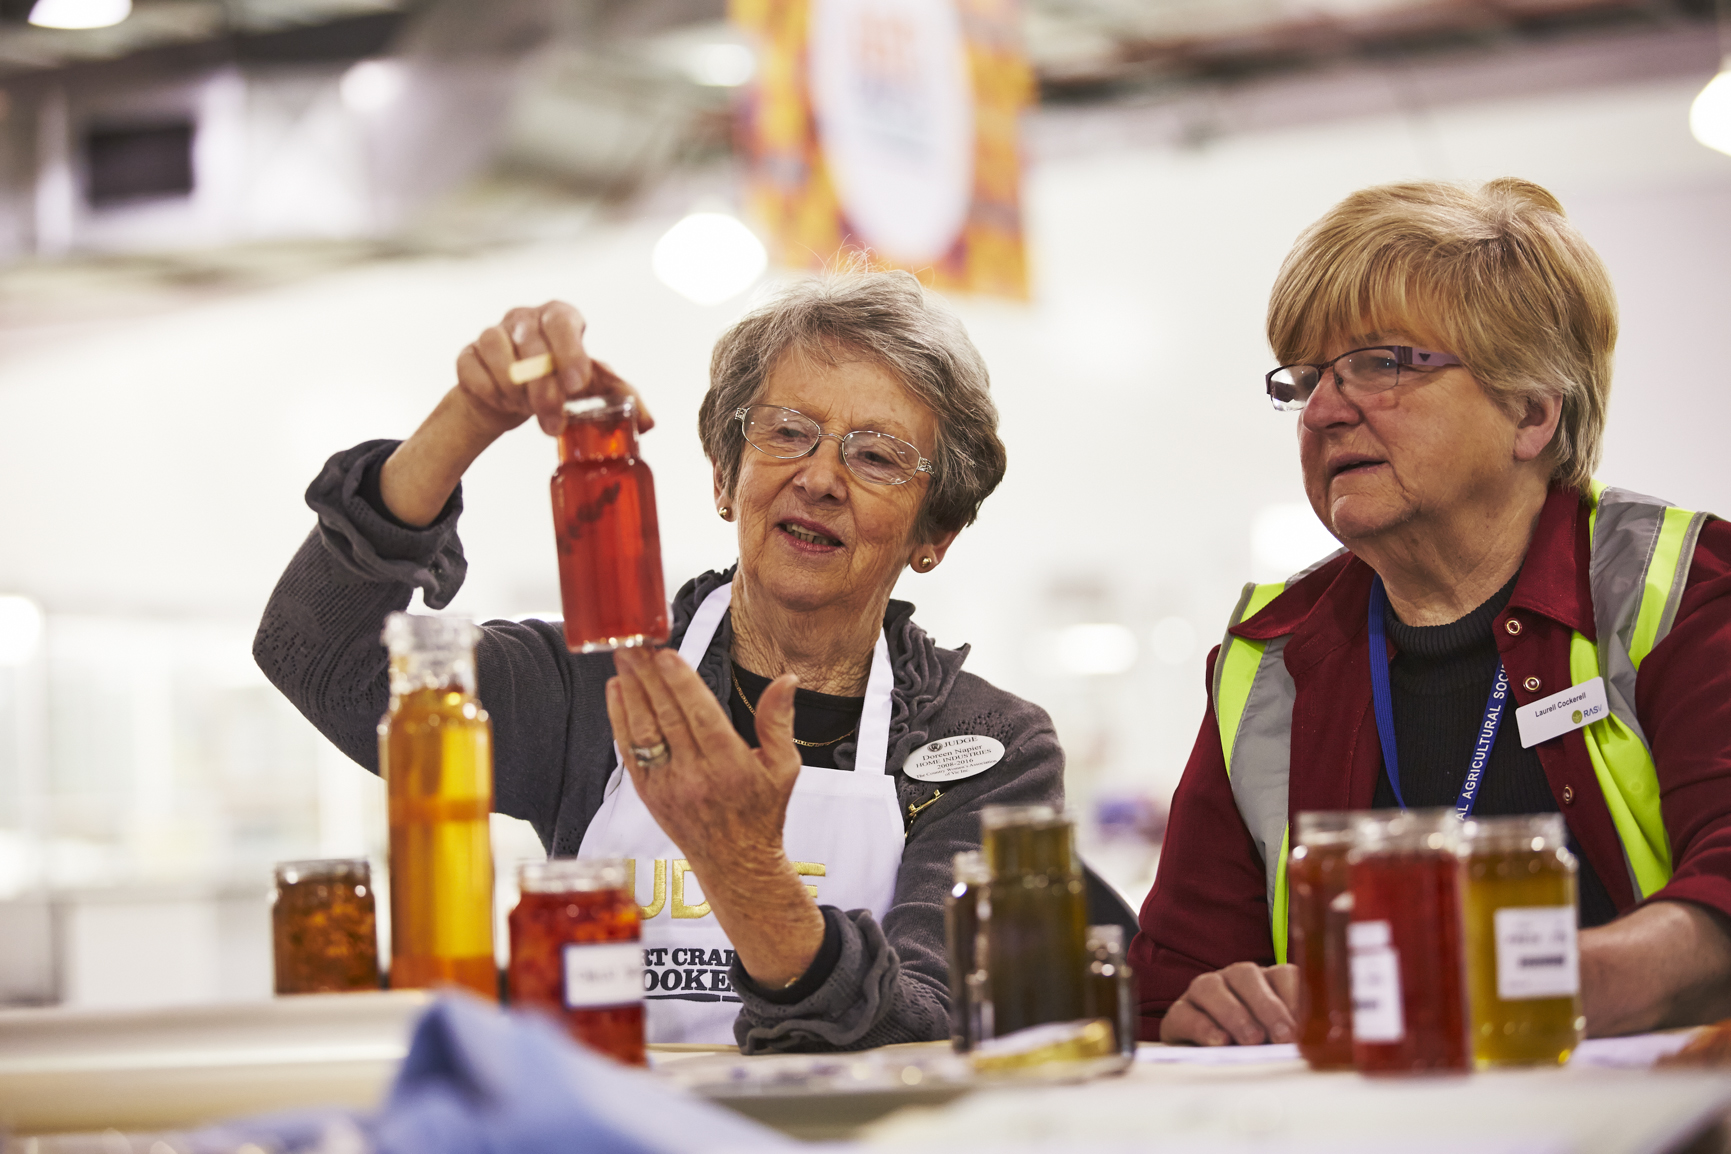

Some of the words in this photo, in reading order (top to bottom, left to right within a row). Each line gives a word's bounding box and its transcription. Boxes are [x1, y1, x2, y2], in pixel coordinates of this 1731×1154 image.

[1534, 704, 1557, 718] Laurell
[1557, 692, 1587, 709] Cockerell
[1462, 704, 1501, 799] AGRICULTURAL
[1493, 664, 1509, 700] SOC
[943, 736, 979, 748] JUDGE
[915, 759, 942, 769] HOME
[943, 748, 992, 763] INDUSTRIES
[922, 750, 953, 761] Doreen
[954, 744, 983, 755] Napier
[926, 769, 946, 777] Country
[937, 759, 974, 770] 2008-2016
[644, 968, 737, 992] OOKE
